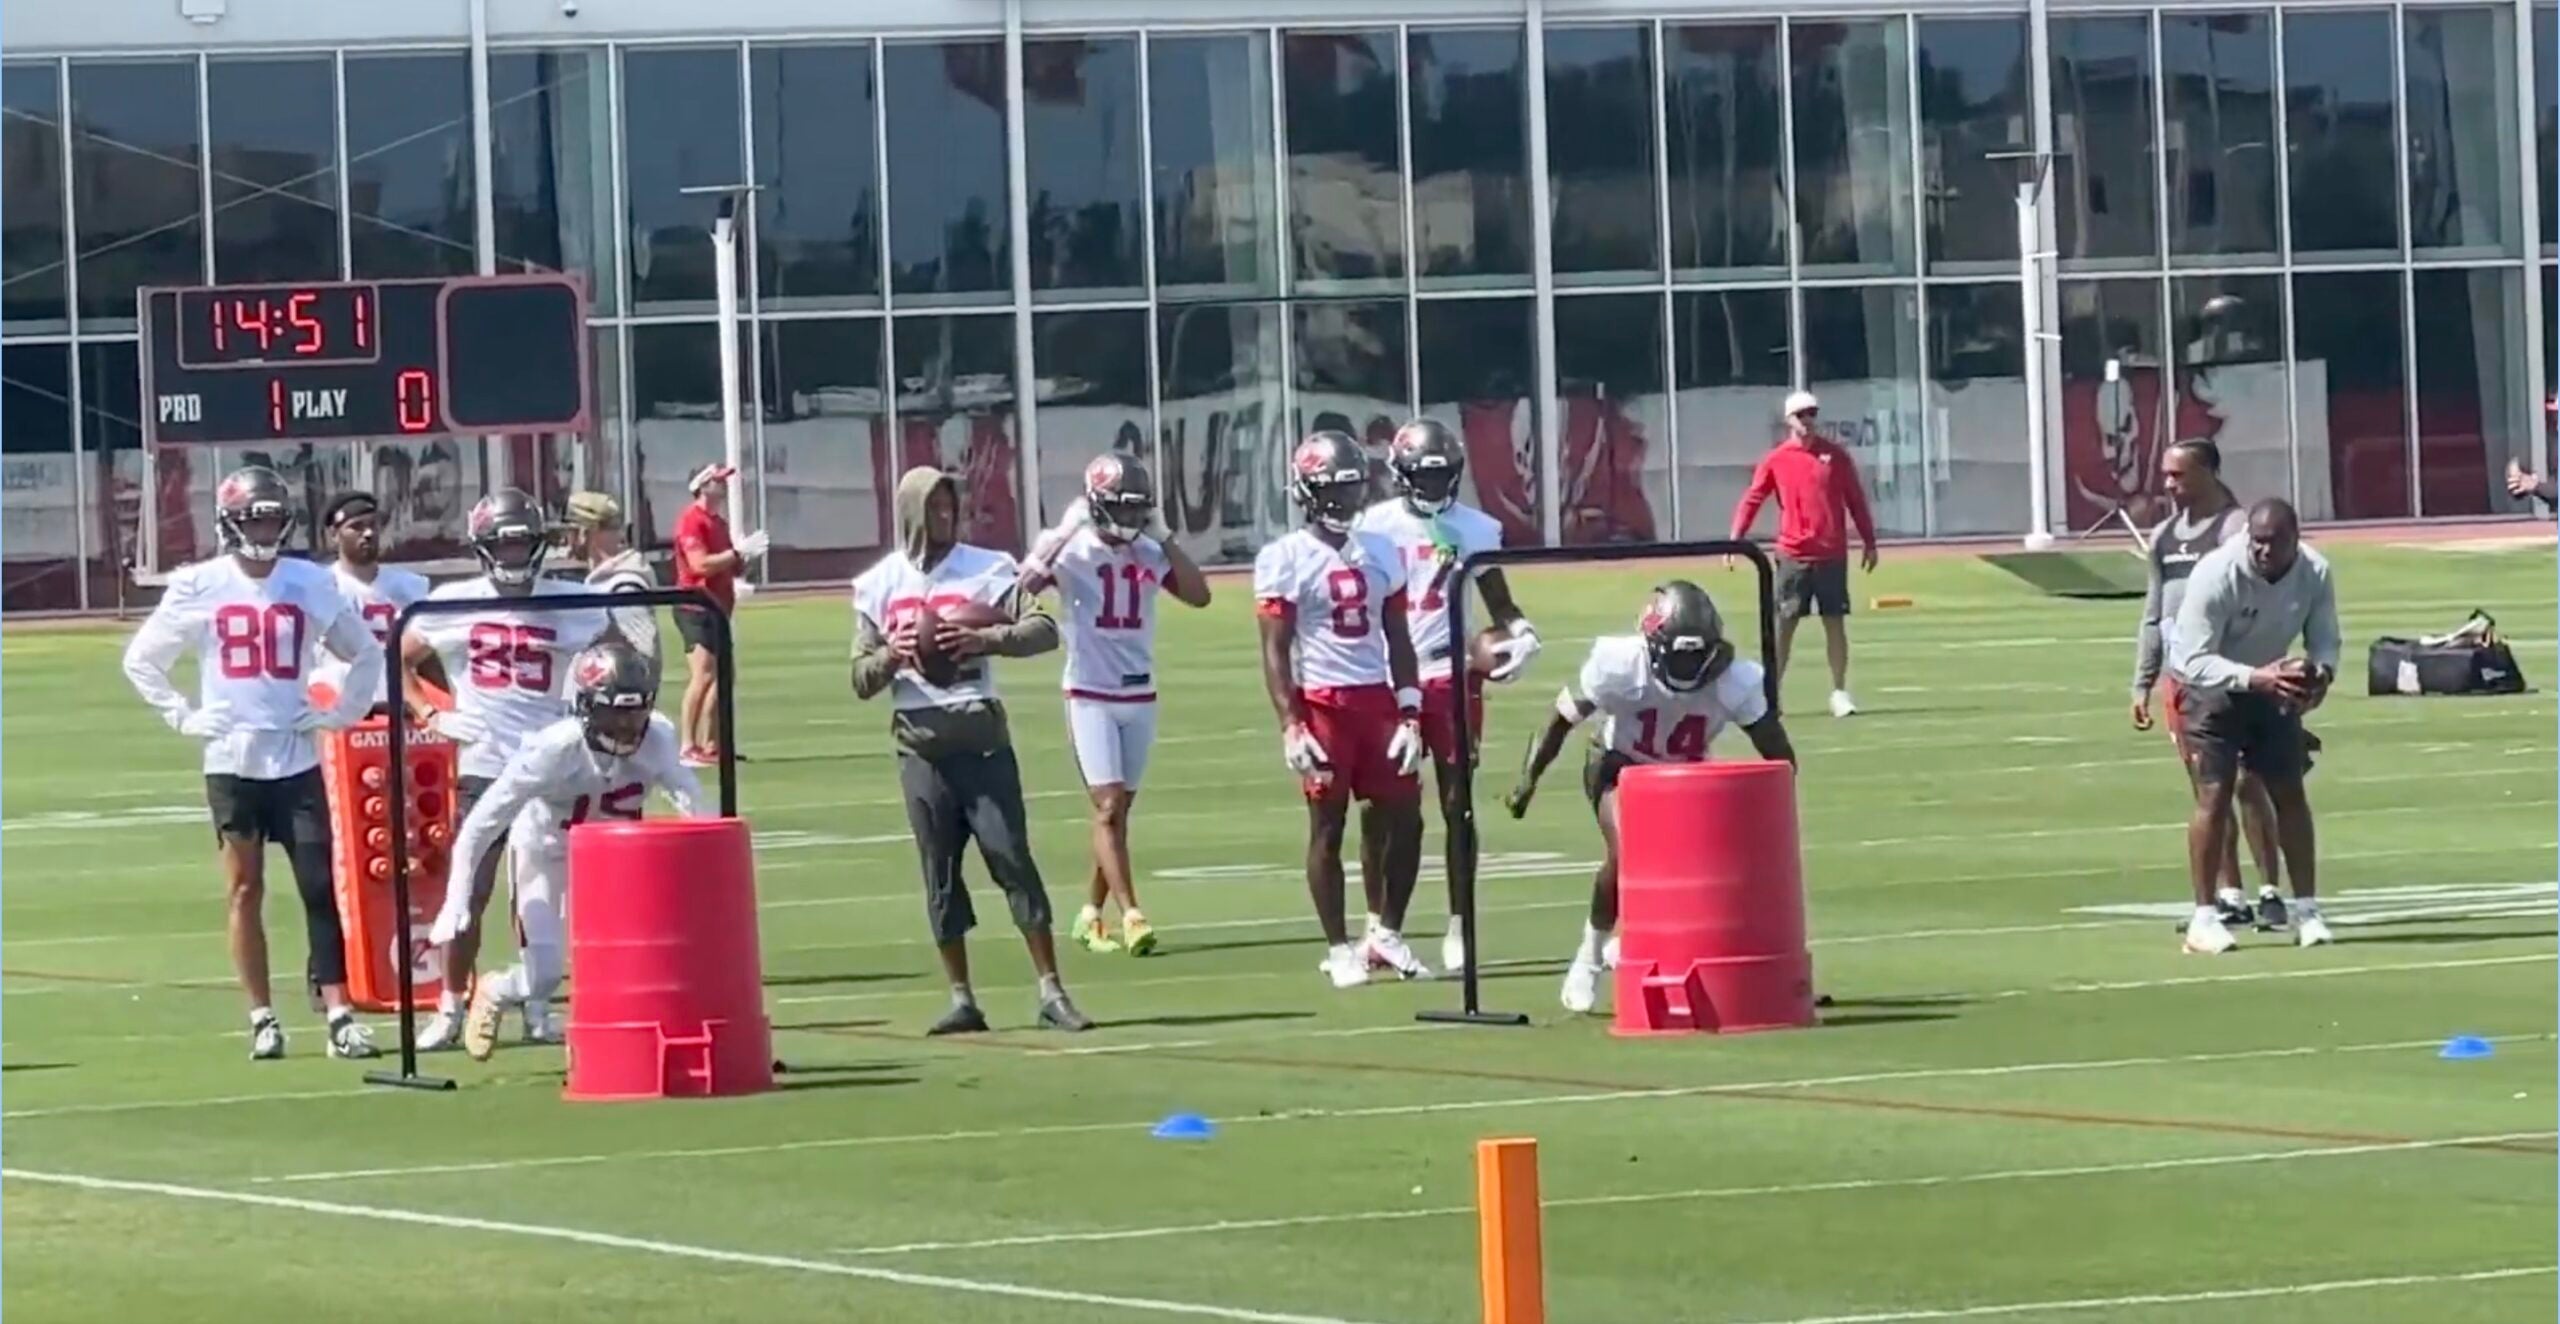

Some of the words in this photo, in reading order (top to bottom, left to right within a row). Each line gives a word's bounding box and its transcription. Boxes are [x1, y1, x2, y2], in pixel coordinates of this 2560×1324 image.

[212, 293, 367, 353] 14:51
[158, 393, 202, 423] PRD
[270, 379, 284, 432] 1
[291, 388, 348, 419] PLAY
[397, 370, 432, 430] 0
[1095, 562, 1143, 630] 11
[1327, 567, 1370, 639] 8
[216, 603, 304, 679] 80
[468, 621, 557, 692] 85
[1632, 708, 1709, 762] 14
